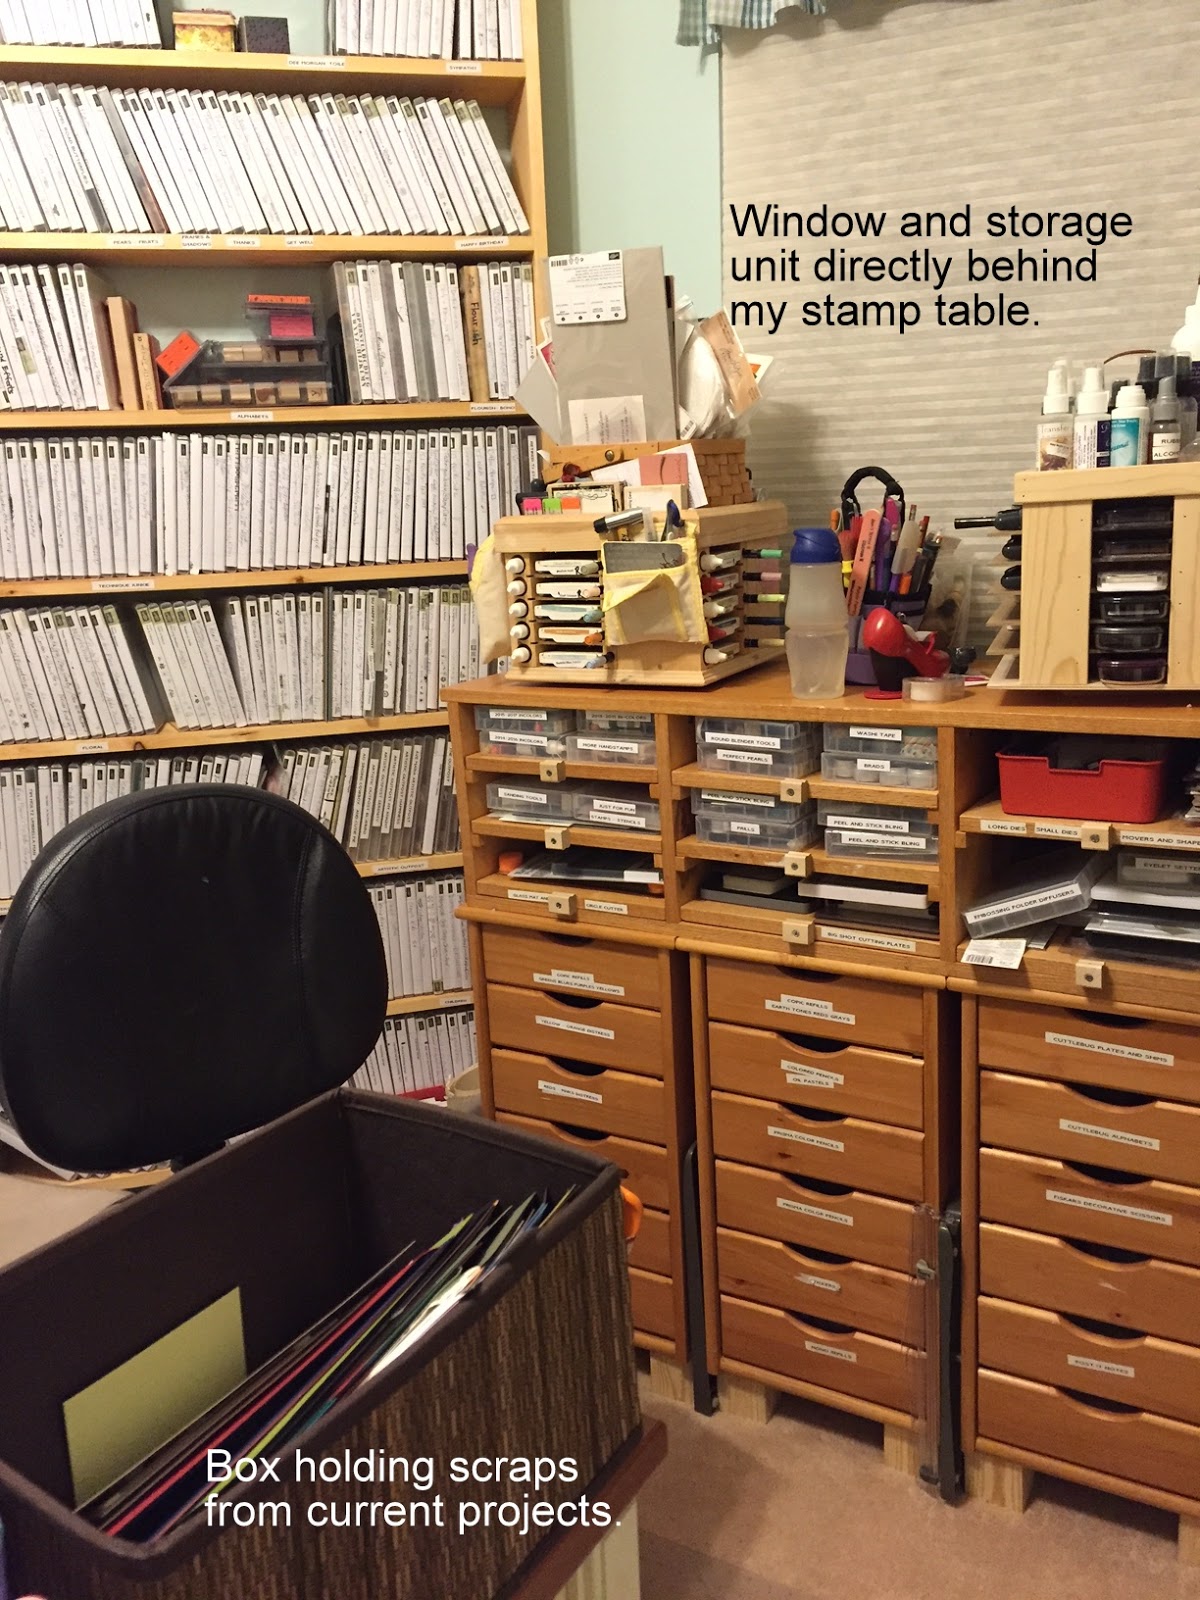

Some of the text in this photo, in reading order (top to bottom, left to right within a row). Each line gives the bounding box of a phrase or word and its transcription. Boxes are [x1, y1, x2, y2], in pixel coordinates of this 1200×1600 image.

[598, 743, 634, 751] HANDSTAMPS
[591, 814, 611, 822] STAMPS
[973, 889, 1075, 920] EMBOSSING FOLDER DIFFUSERS
[858, 937, 885, 945] CUTTING
[886, 941, 911, 949] PLATES
[596, 986, 620, 994] YELLOWS
[806, 1001, 828, 1009] REFILLS
[792, 1007, 811, 1015] TONES
[830, 1014, 850, 1022] GRAYS
[566, 1024, 585, 1032] ORANGE
[586, 1028, 611, 1037] DISTRESS
[1053, 1036, 1095, 1049] CUTTLEBUG
[1097, 1045, 1125, 1055] PLATES
[1126, 1050, 1142, 1058] AND
[786, 1064, 839, 1082] COLORED PENCILS
[804, 1078, 829, 1086] PASTELS
[794, 1134, 815, 1143] COLOR
[816, 1139, 839, 1149] PENCILS
[1067, 1123, 1153, 1147] CUTTLEBUG ALPHABETS
[804, 1207, 824, 1216] COLOR
[825, 1213, 848, 1223] PENCILS
[1053, 1195, 1166, 1222] FISKARS DECORATIVE SCISSORS
[1074, 1359, 1094, 1367] POST
[1104, 1364, 1129, 1374] NOTES
